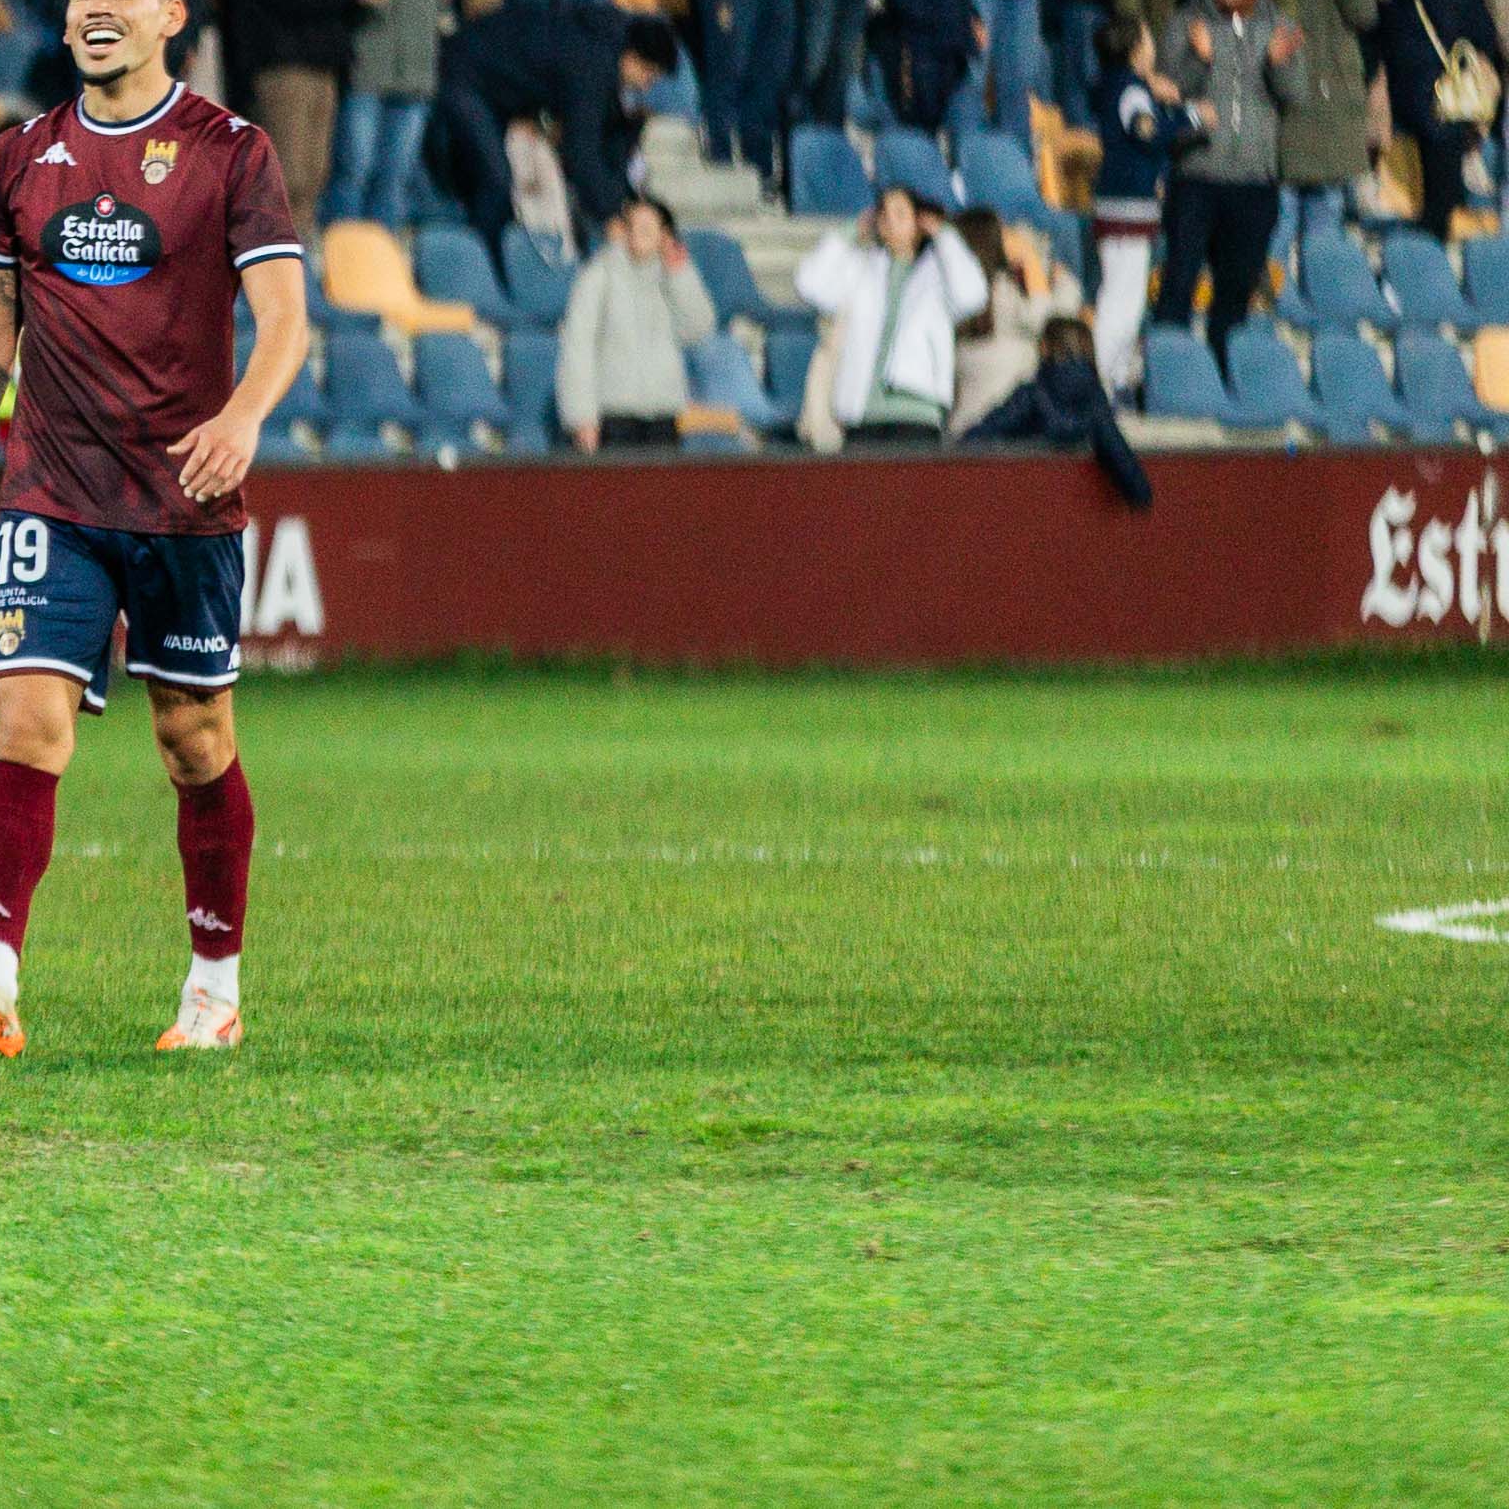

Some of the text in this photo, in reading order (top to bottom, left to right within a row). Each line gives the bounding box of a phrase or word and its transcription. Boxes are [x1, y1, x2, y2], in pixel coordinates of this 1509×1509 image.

[60, 215, 145, 241] Estrella
[62, 238, 141, 262] Galicia
[7, 595, 49, 606] GALICIA
